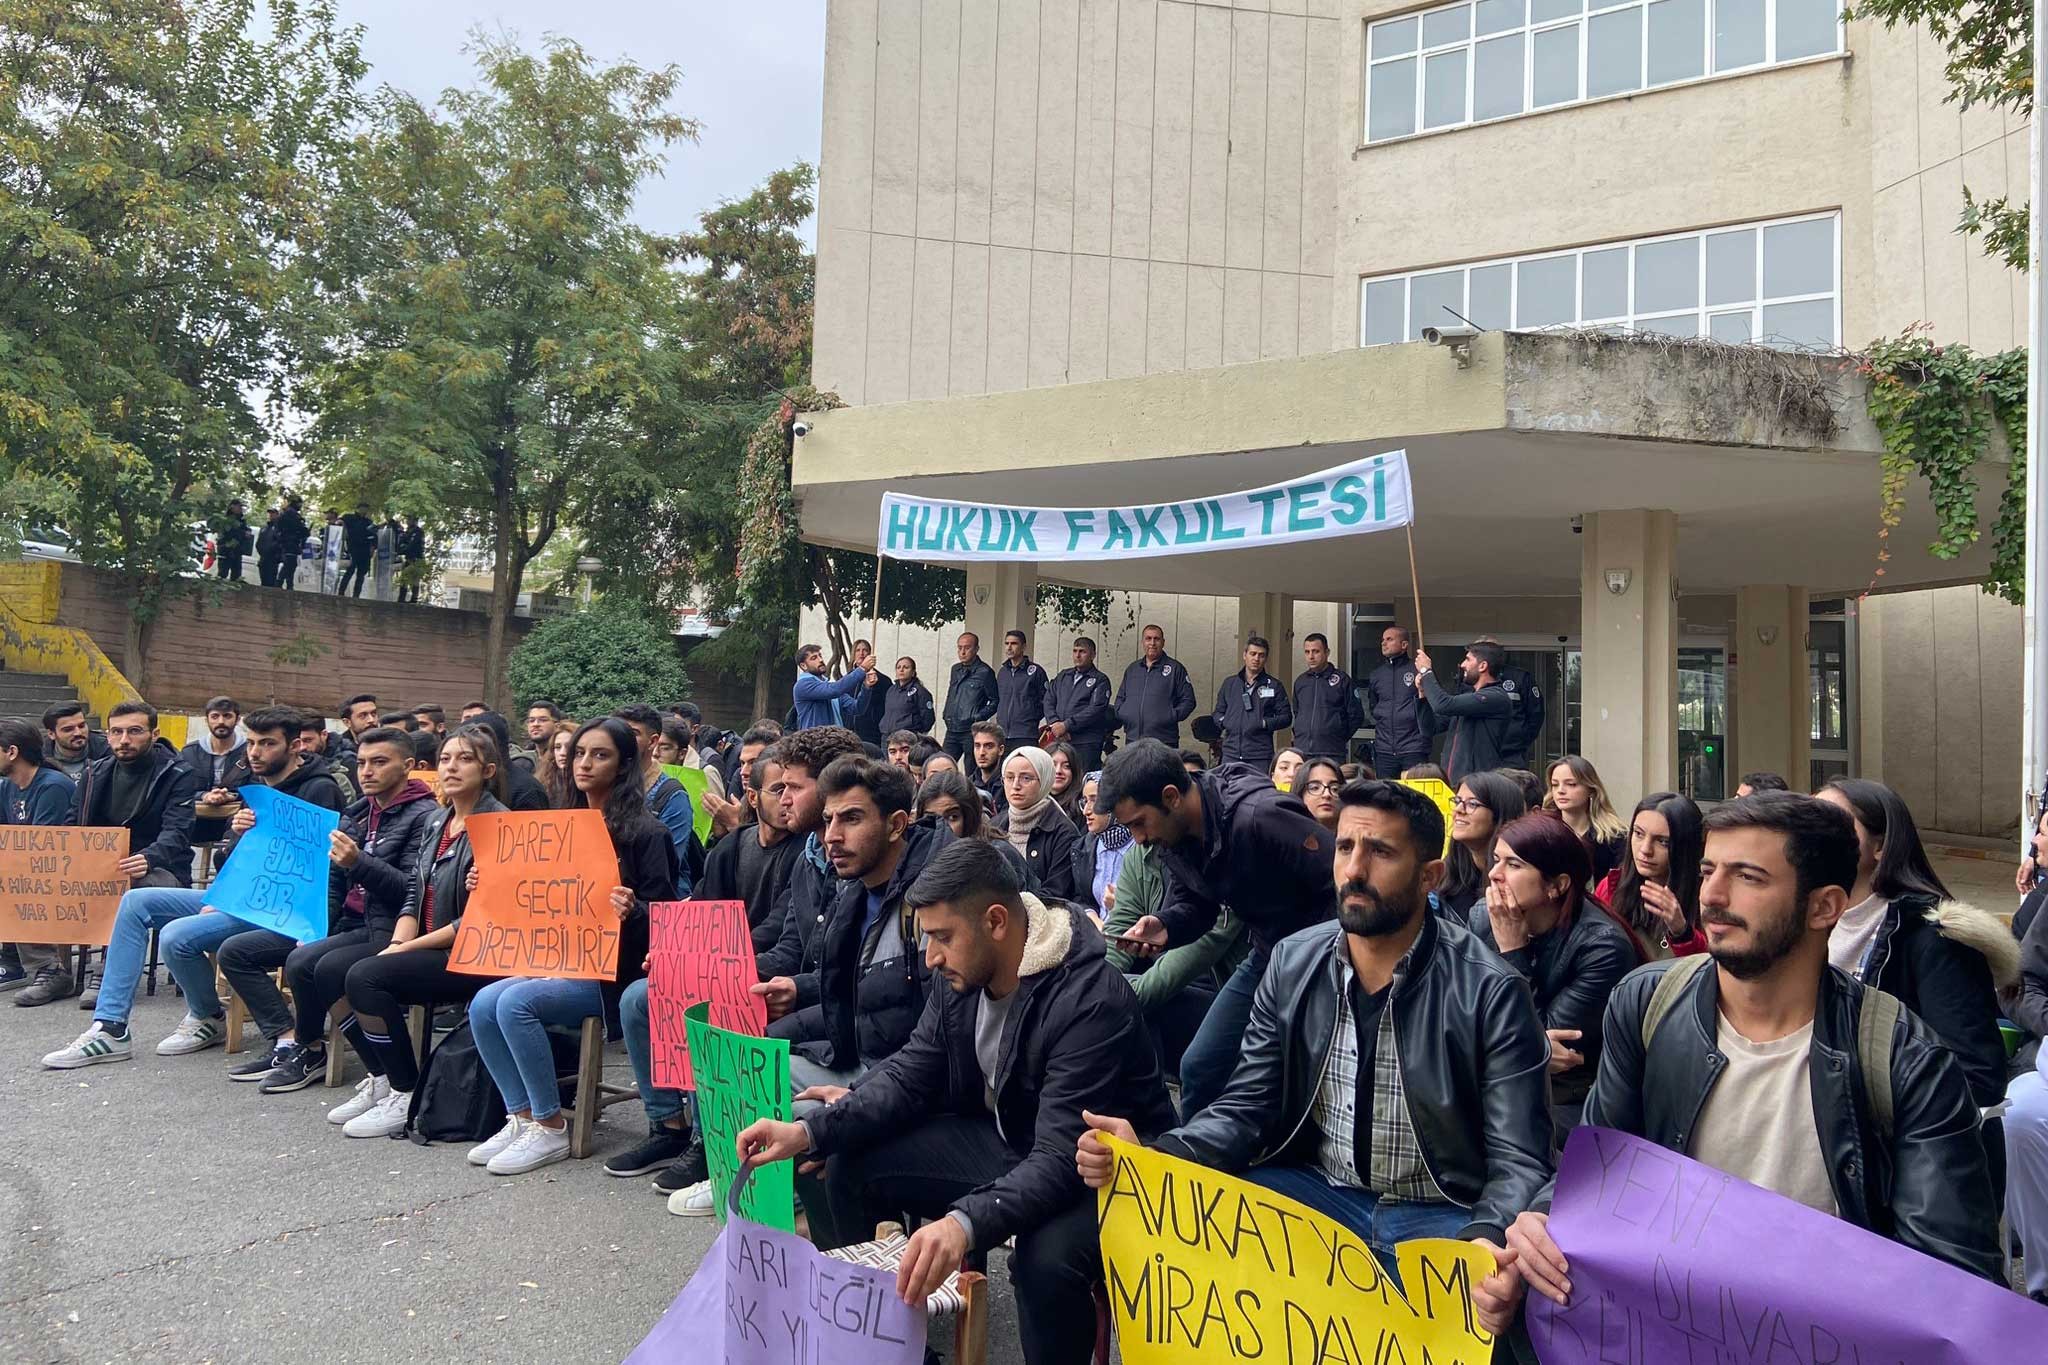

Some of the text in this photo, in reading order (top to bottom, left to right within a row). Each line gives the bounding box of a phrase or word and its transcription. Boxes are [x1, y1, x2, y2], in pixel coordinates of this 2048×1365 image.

[885, 504, 1038, 552] HUKUK
[80, 831, 120, 851] YOK
[495, 815, 575, 864] İDAREYİ
[8, 874, 54, 895] MİRAS
[245, 873, 296, 928] BİR
[515, 873, 597, 919] GEÇTİK
[14, 903, 48, 921] VAR
[454, 921, 618, 975] DİRENEBİLİRİZ
[668, 952, 696, 1000] YIL
[649, 998, 687, 1044] VARD
[652, 1043, 695, 1086] HAT
[1592, 1131, 1731, 1250] YENİ
[1099, 1154, 1304, 1278] AVUKAT
[809, 1259, 906, 1345] DEĞİL
[1108, 1252, 1264, 1360] MİRAS
